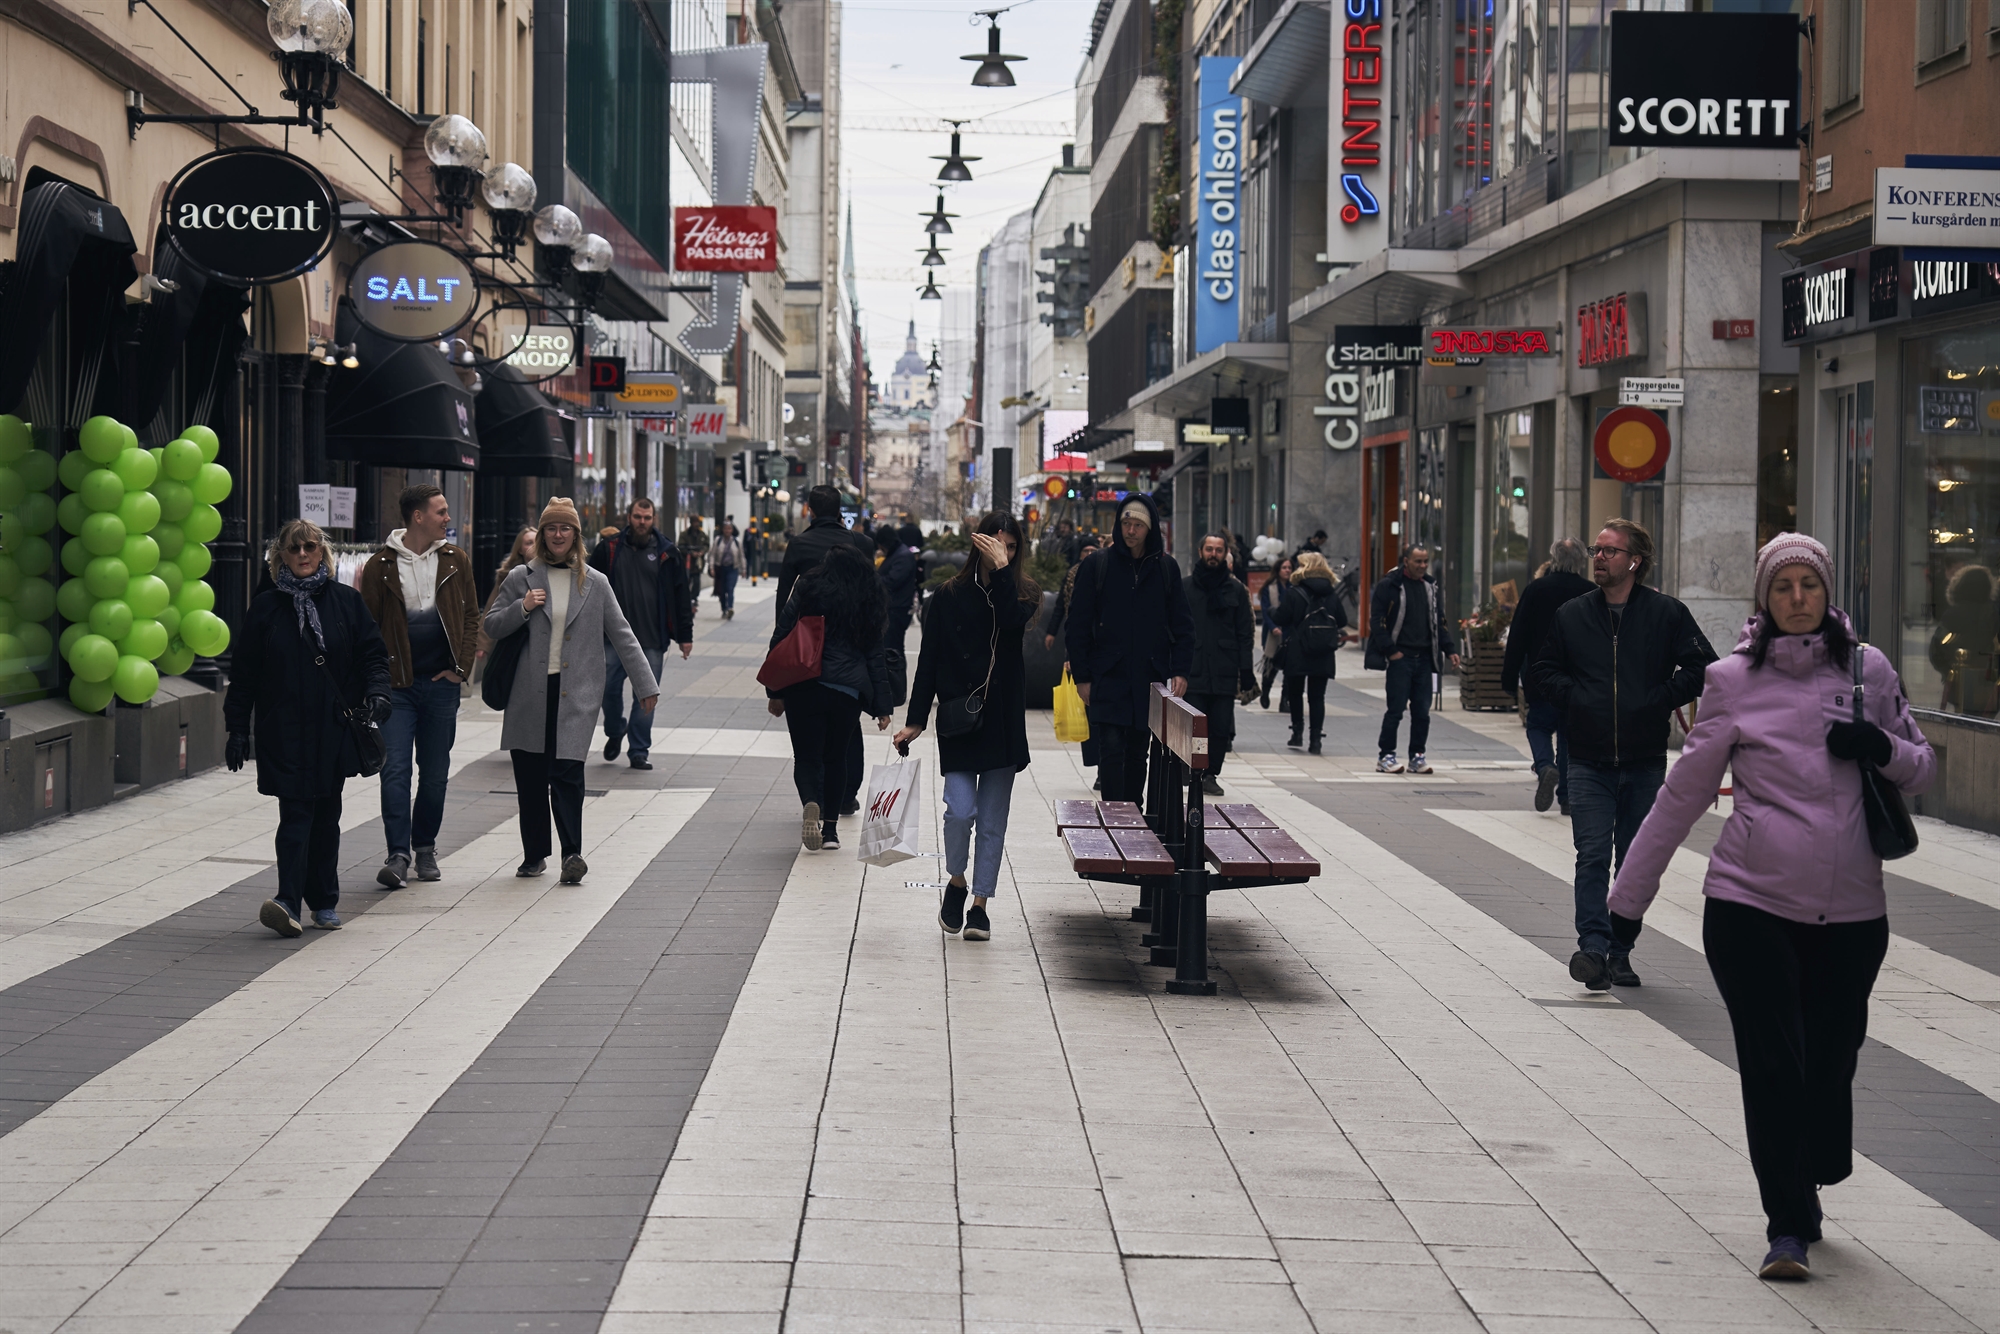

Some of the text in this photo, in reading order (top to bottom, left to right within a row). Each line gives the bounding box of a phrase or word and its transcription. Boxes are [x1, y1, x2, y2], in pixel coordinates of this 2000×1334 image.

[1618, 97, 1791, 136] SCORETT
[1203, 108, 1237, 301] clas ohlson
[178, 200, 321, 231] accent
[1911, 212, 1987, 228] kursgården
[682, 215, 771, 248] Hötorgs
[686, 247, 765, 260] PASSAGEN
[367, 276, 460, 302] SALT
[1805, 267, 1847, 326] SCORETT
[1734, 324, 1750, 335] 0,5
[510, 334, 569, 351] VERO
[1340, 342, 1423, 361] stadium
[505, 351, 572, 367] MODA
[1626, 380, 1680, 391] Bryggargatan
[1626, 393, 1640, 402] 1-9
[304, 503, 325, 512] 50%
[867, 788, 901, 822] H&M
